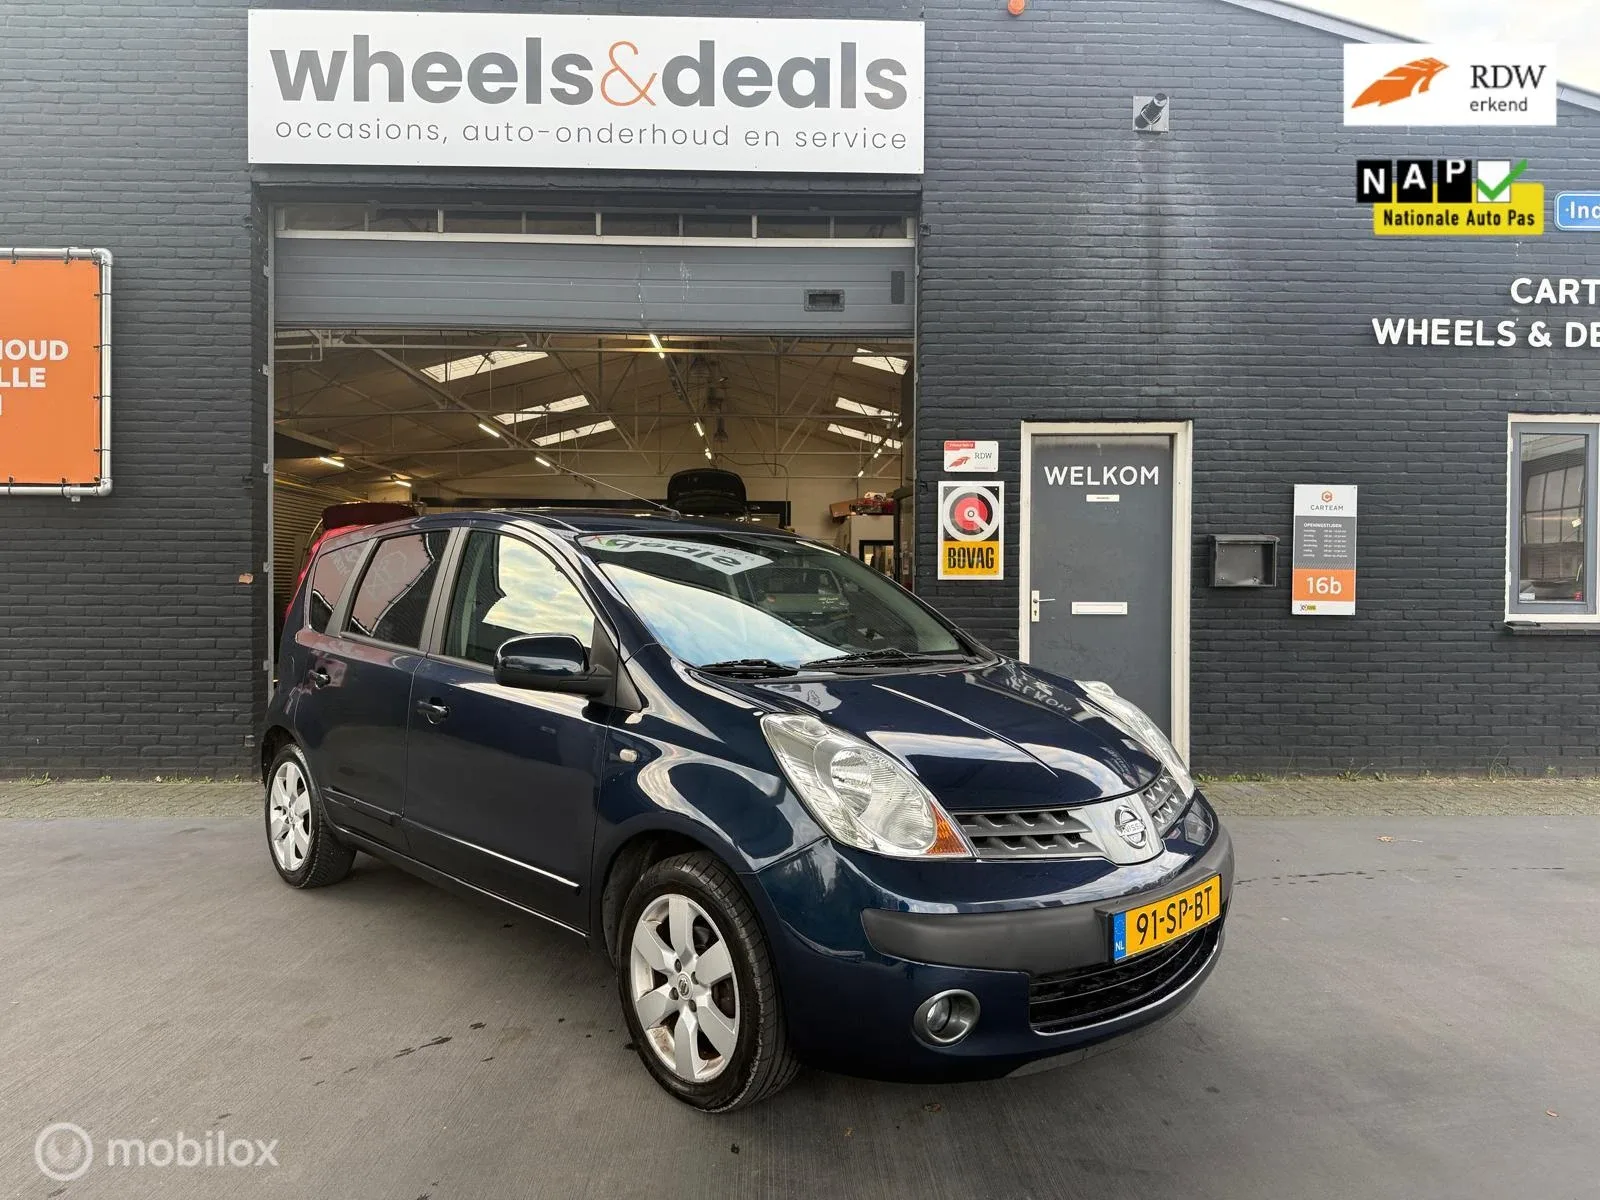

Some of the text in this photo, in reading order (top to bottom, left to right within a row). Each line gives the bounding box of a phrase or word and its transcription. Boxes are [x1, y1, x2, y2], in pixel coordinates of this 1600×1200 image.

[275, 117, 908, 151] occasions, auto-onderhoud en service
[1510, 277, 1600, 305] CART
[1371, 317, 1517, 347] WHEELS
[1527, 321, 1553, 348] &
[1044, 465, 1160, 486] WELKOM
[947, 546, 995, 570] BOVAG
[1306, 576, 1342, 595] 16b
[1136, 885, 1213, 945] 91-SP-BT
[1115, 942, 1125, 951] NL
